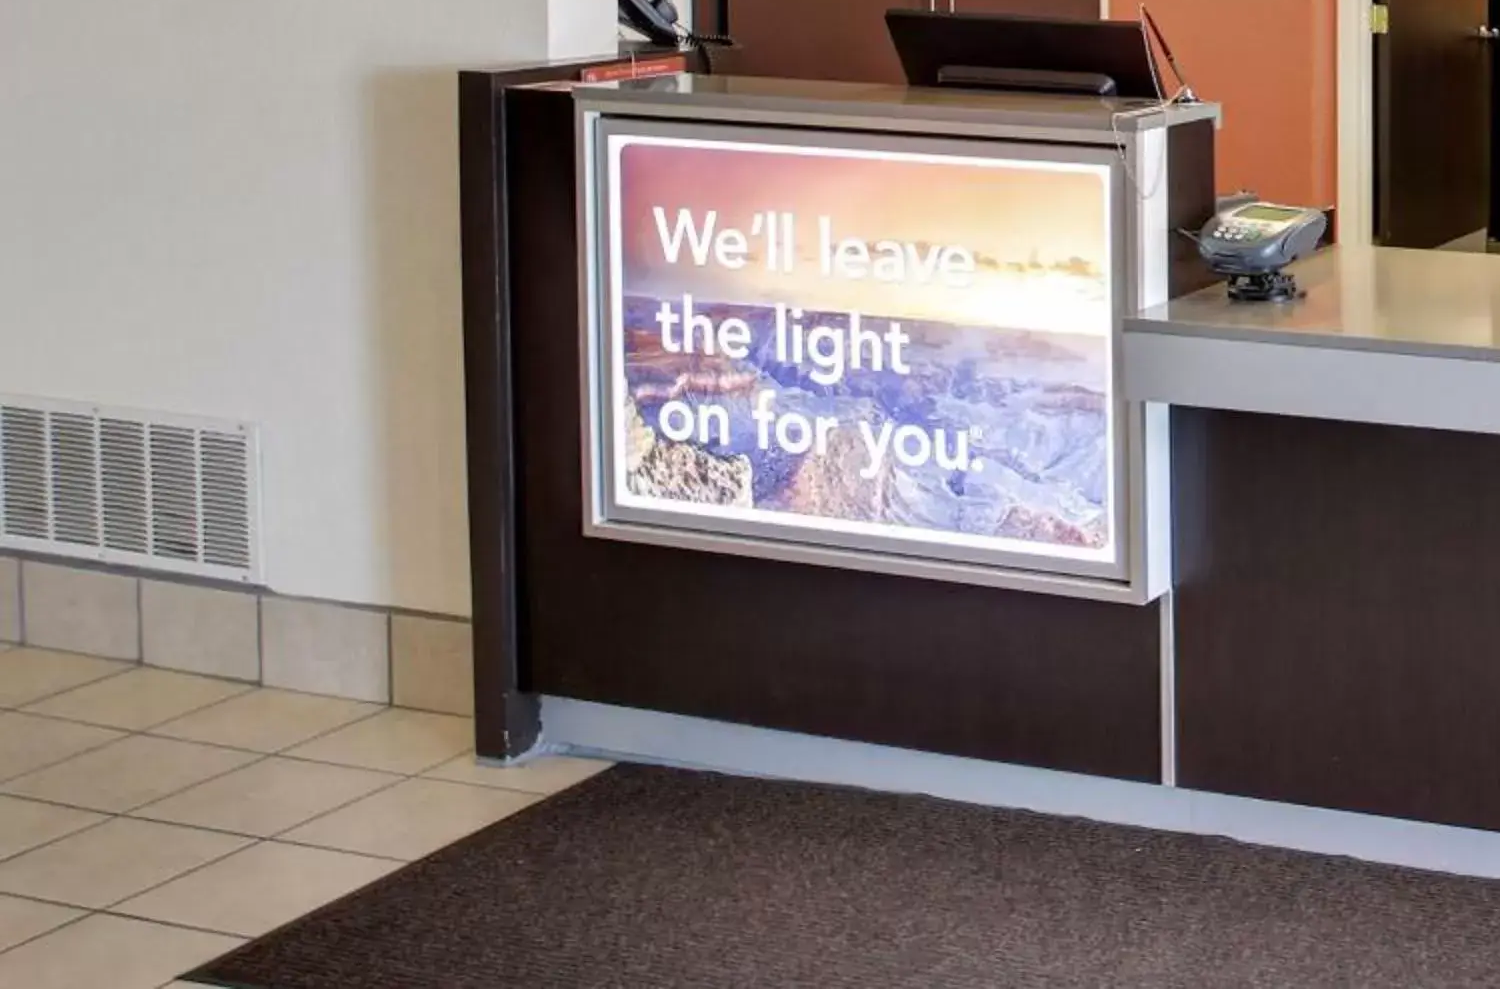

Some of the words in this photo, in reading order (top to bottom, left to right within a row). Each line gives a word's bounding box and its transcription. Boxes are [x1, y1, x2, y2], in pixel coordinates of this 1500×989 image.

[653, 206, 793, 273] We'll
[818, 215, 976, 288] leave
[656, 294, 751, 358] the
[775, 303, 910, 386] light
[659, 400, 730, 447] on
[752, 390, 839, 455] for
[859, 420, 984, 480] you.
